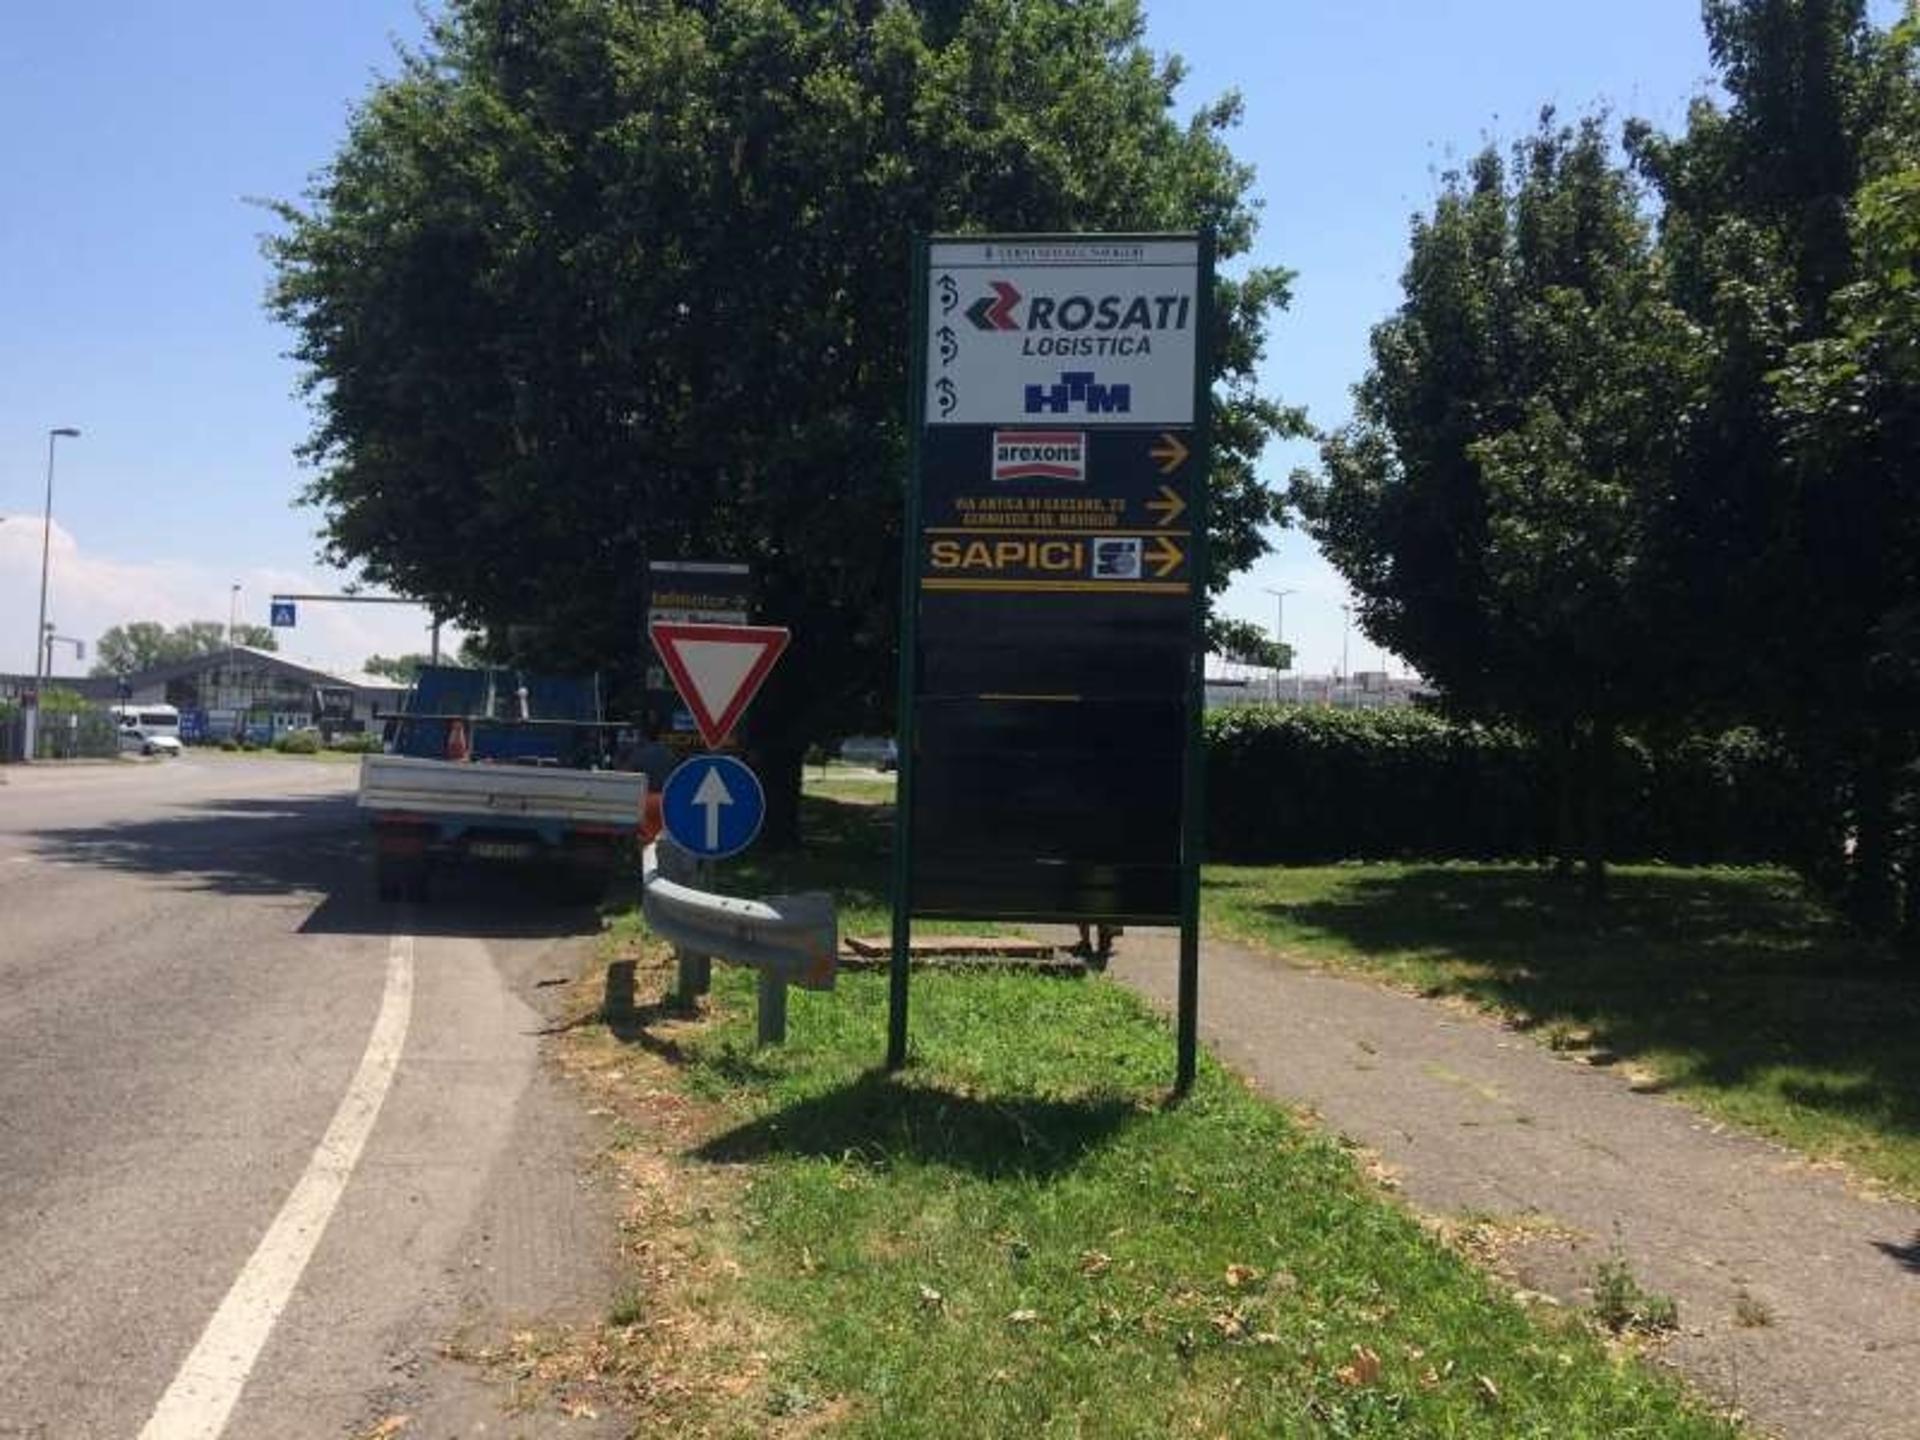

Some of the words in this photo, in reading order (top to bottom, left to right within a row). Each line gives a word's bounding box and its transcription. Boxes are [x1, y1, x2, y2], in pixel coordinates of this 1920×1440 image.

[1027, 295, 1190, 331] ROSATI
[1022, 336, 1151, 357] LOGISTICA
[1024, 371, 1131, 413] HTM
[997, 443, 1081, 462] arexons
[930, 540, 1084, 570] SAPICI
